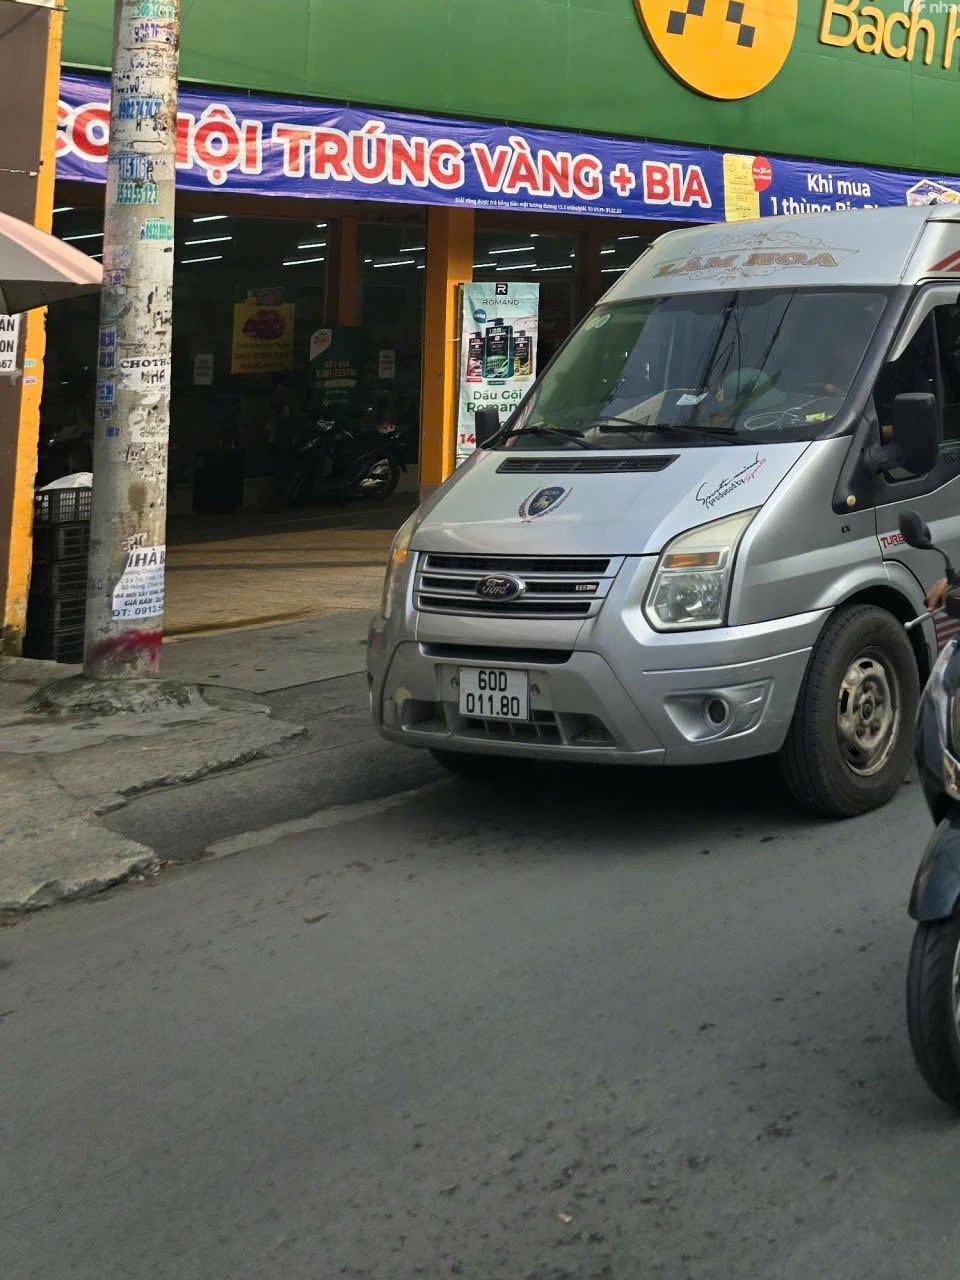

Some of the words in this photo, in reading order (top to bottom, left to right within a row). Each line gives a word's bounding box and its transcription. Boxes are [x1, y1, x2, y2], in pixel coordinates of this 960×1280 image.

[275, 121, 464, 189] TRÚNG
[472, 137, 603, 197] VÀNG
[644, 162, 712, 207] BIA
[806, 173, 833, 193] Khi
[837, 180, 871, 197] mua
[770, 196, 778, 215] 1
[782, 196, 831, 215] thùng
[743, 252, 838, 267] HOA
[473, 390, 497, 400] Dầu
[501, 388, 522, 402] Gội
[466, 402, 518, 413] Roman
[880, 532, 906, 549] TURB
[481, 578, 511, 595] Ford
[478, 669, 508, 692] 60D
[466, 692, 521, 717] 011.80
